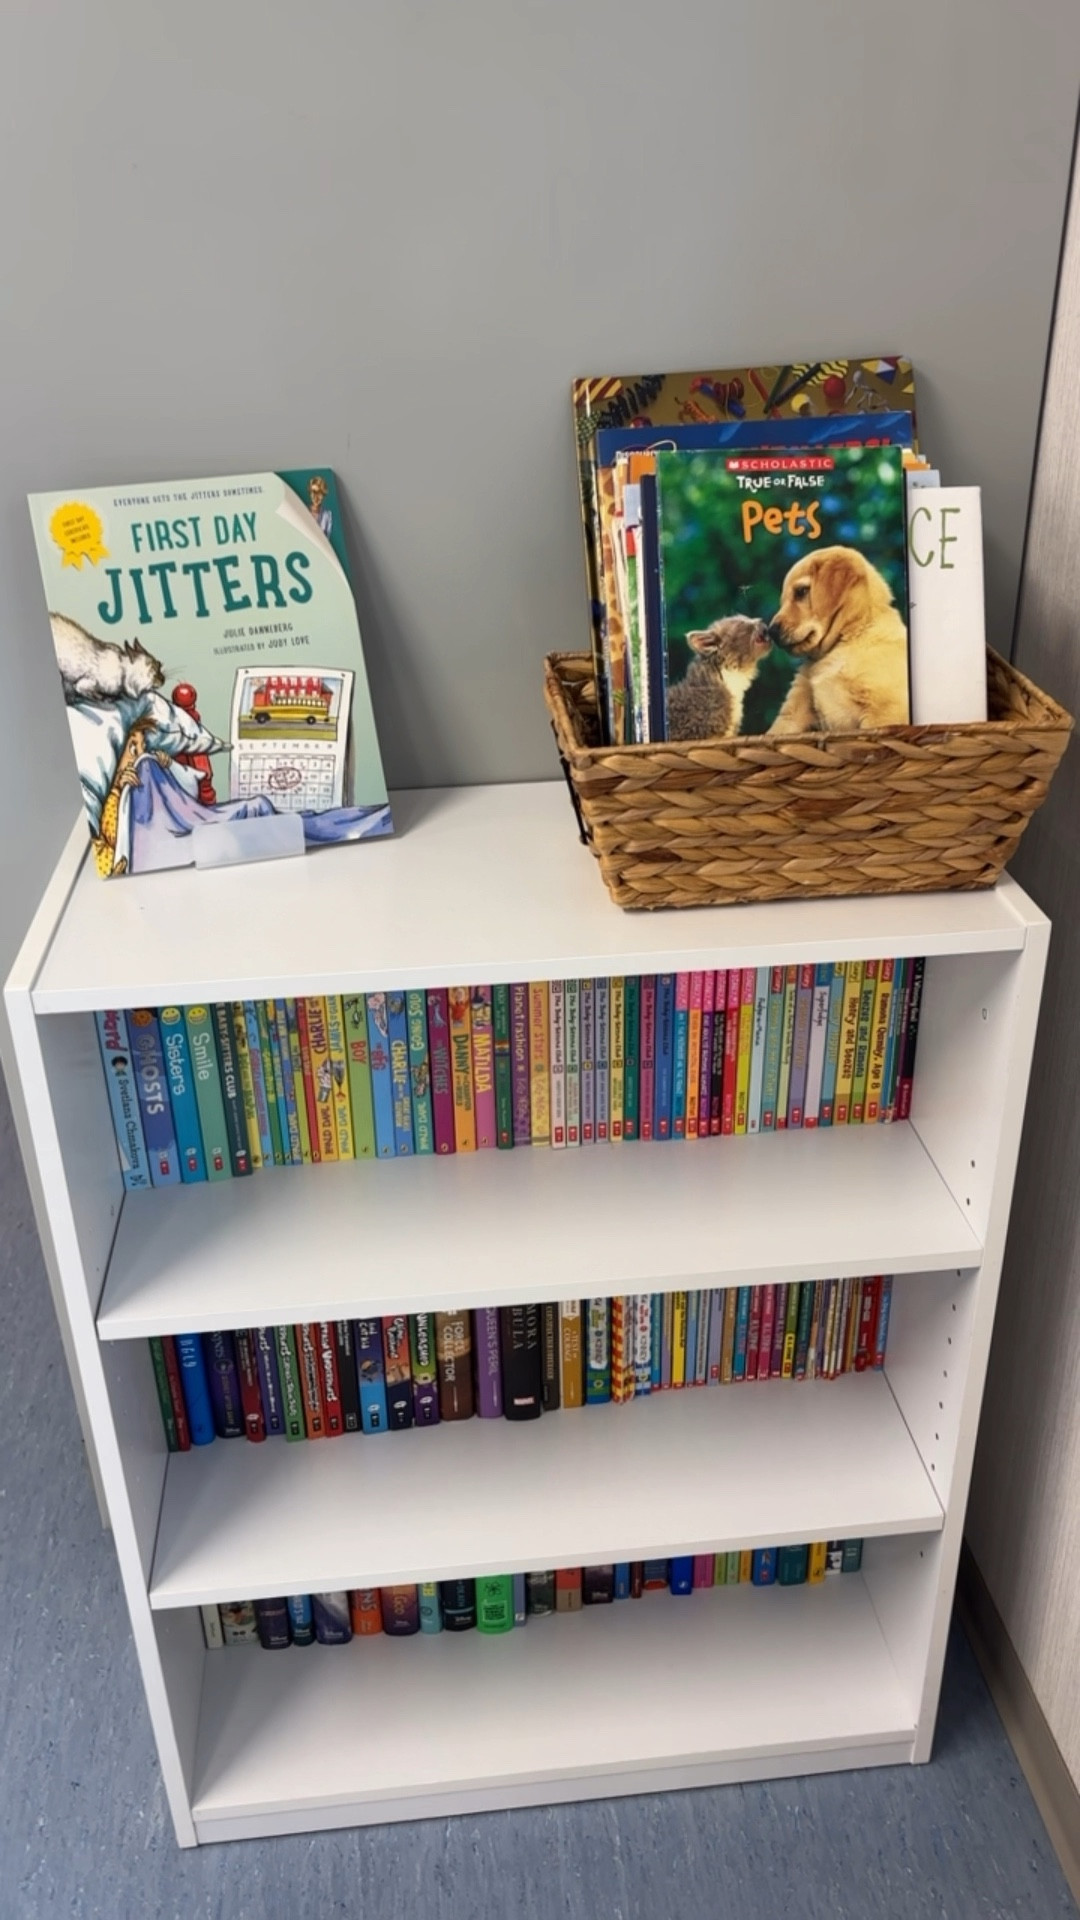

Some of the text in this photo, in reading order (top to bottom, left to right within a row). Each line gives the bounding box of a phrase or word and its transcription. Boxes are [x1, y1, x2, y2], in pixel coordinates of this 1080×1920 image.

[739, 458, 832, 469] SCHOLASTIC
[173, 492, 187, 501] THE
[190, 489, 220, 500] JITTERS
[736, 475, 771, 493] TRUE
[787, 474, 825, 489] FALSE
[130, 511, 257, 553] FIRST DAY
[741, 500, 822, 543] Pets
[909, 507, 961, 569] CE
[97, 551, 314, 625] JITTERS
[223, 622, 294, 639] JULIE DANNEBERG
[268, 638, 288, 649] JUDY
[291, 635, 311, 646] LOVE
[408, 993, 422, 1016] SOLO
[514, 986, 525, 1020] Planet
[844, 997, 858, 1025] Henry
[878, 993, 889, 1024] Ramona
[308, 1007, 327, 1055] CHARLIE
[410, 1019, 425, 1051] GOING
[166, 1033, 186, 1096] Sisters
[192, 1031, 214, 1081] Smile
[350, 1040, 367, 1065] BOY
[391, 1039, 408, 1085] CHARLIE
[433, 1046, 448, 1095] WITCHES
[453, 1033, 470, 1075] DANNY
[472, 1033, 492, 1094] MATILDA
[872, 1061, 882, 1079] Age
[136, 1034, 165, 1115] GHOSTS
[224, 1074, 237, 1099] CLUB
[451, 1320, 465, 1353] FORCE
[511, 1307, 524, 1350] BULA
[526, 1304, 537, 1350] MORA
[564, 1327, 573, 1362] COURAGE
[443, 1325, 456, 1383] COLLECTOR
